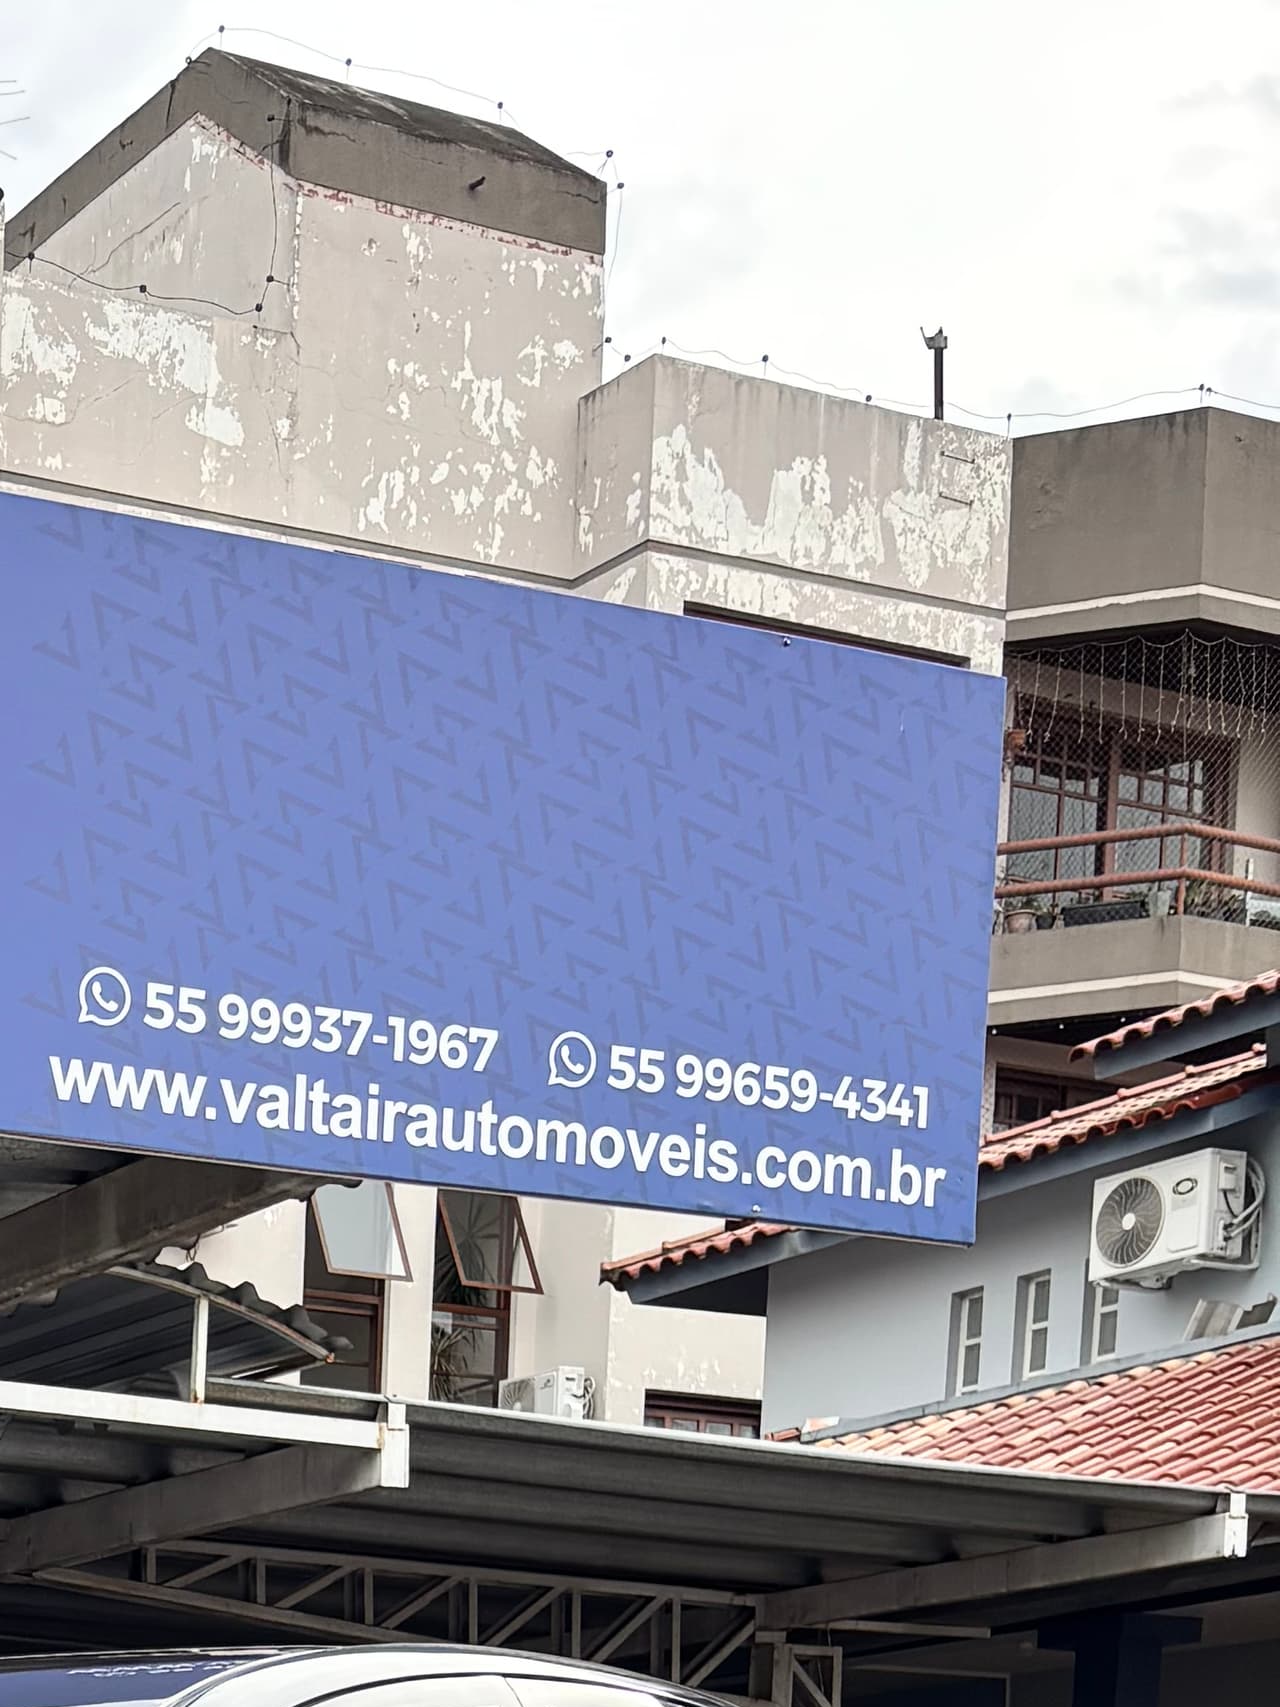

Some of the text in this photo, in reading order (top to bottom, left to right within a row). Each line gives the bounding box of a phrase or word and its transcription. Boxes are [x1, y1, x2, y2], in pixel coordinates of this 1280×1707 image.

[144, 982, 498, 1071] 55 99937-1967
[608, 1044, 928, 1128] 55 99659-4341
[49, 1056, 946, 1206] www.valtairautomoveis.com.br
